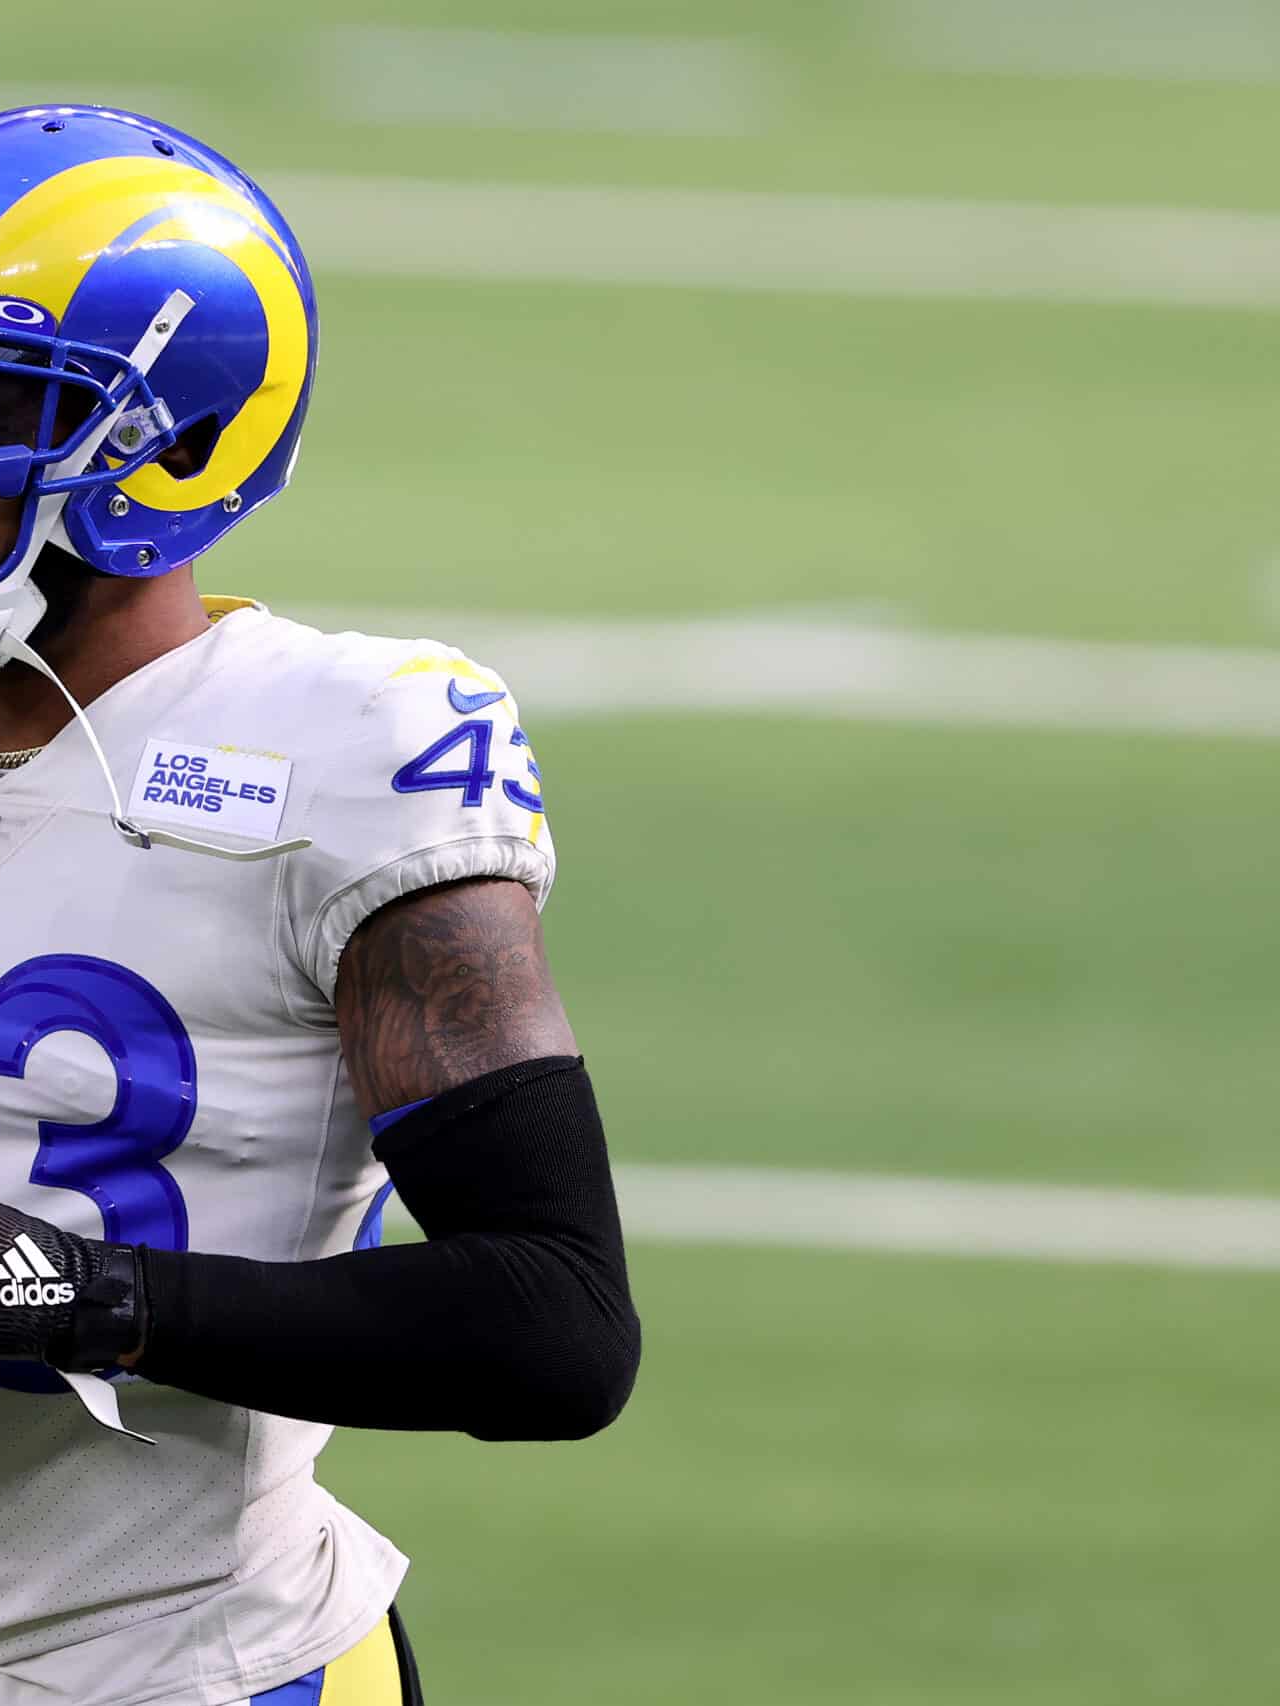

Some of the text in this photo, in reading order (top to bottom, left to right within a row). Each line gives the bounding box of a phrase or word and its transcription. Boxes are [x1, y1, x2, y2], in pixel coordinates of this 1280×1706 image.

[154, 752, 209, 773] LOS
[391, 719, 545, 813] 43
[143, 786, 223, 813] RAMS
[148, 771, 277, 804] ANGELES
